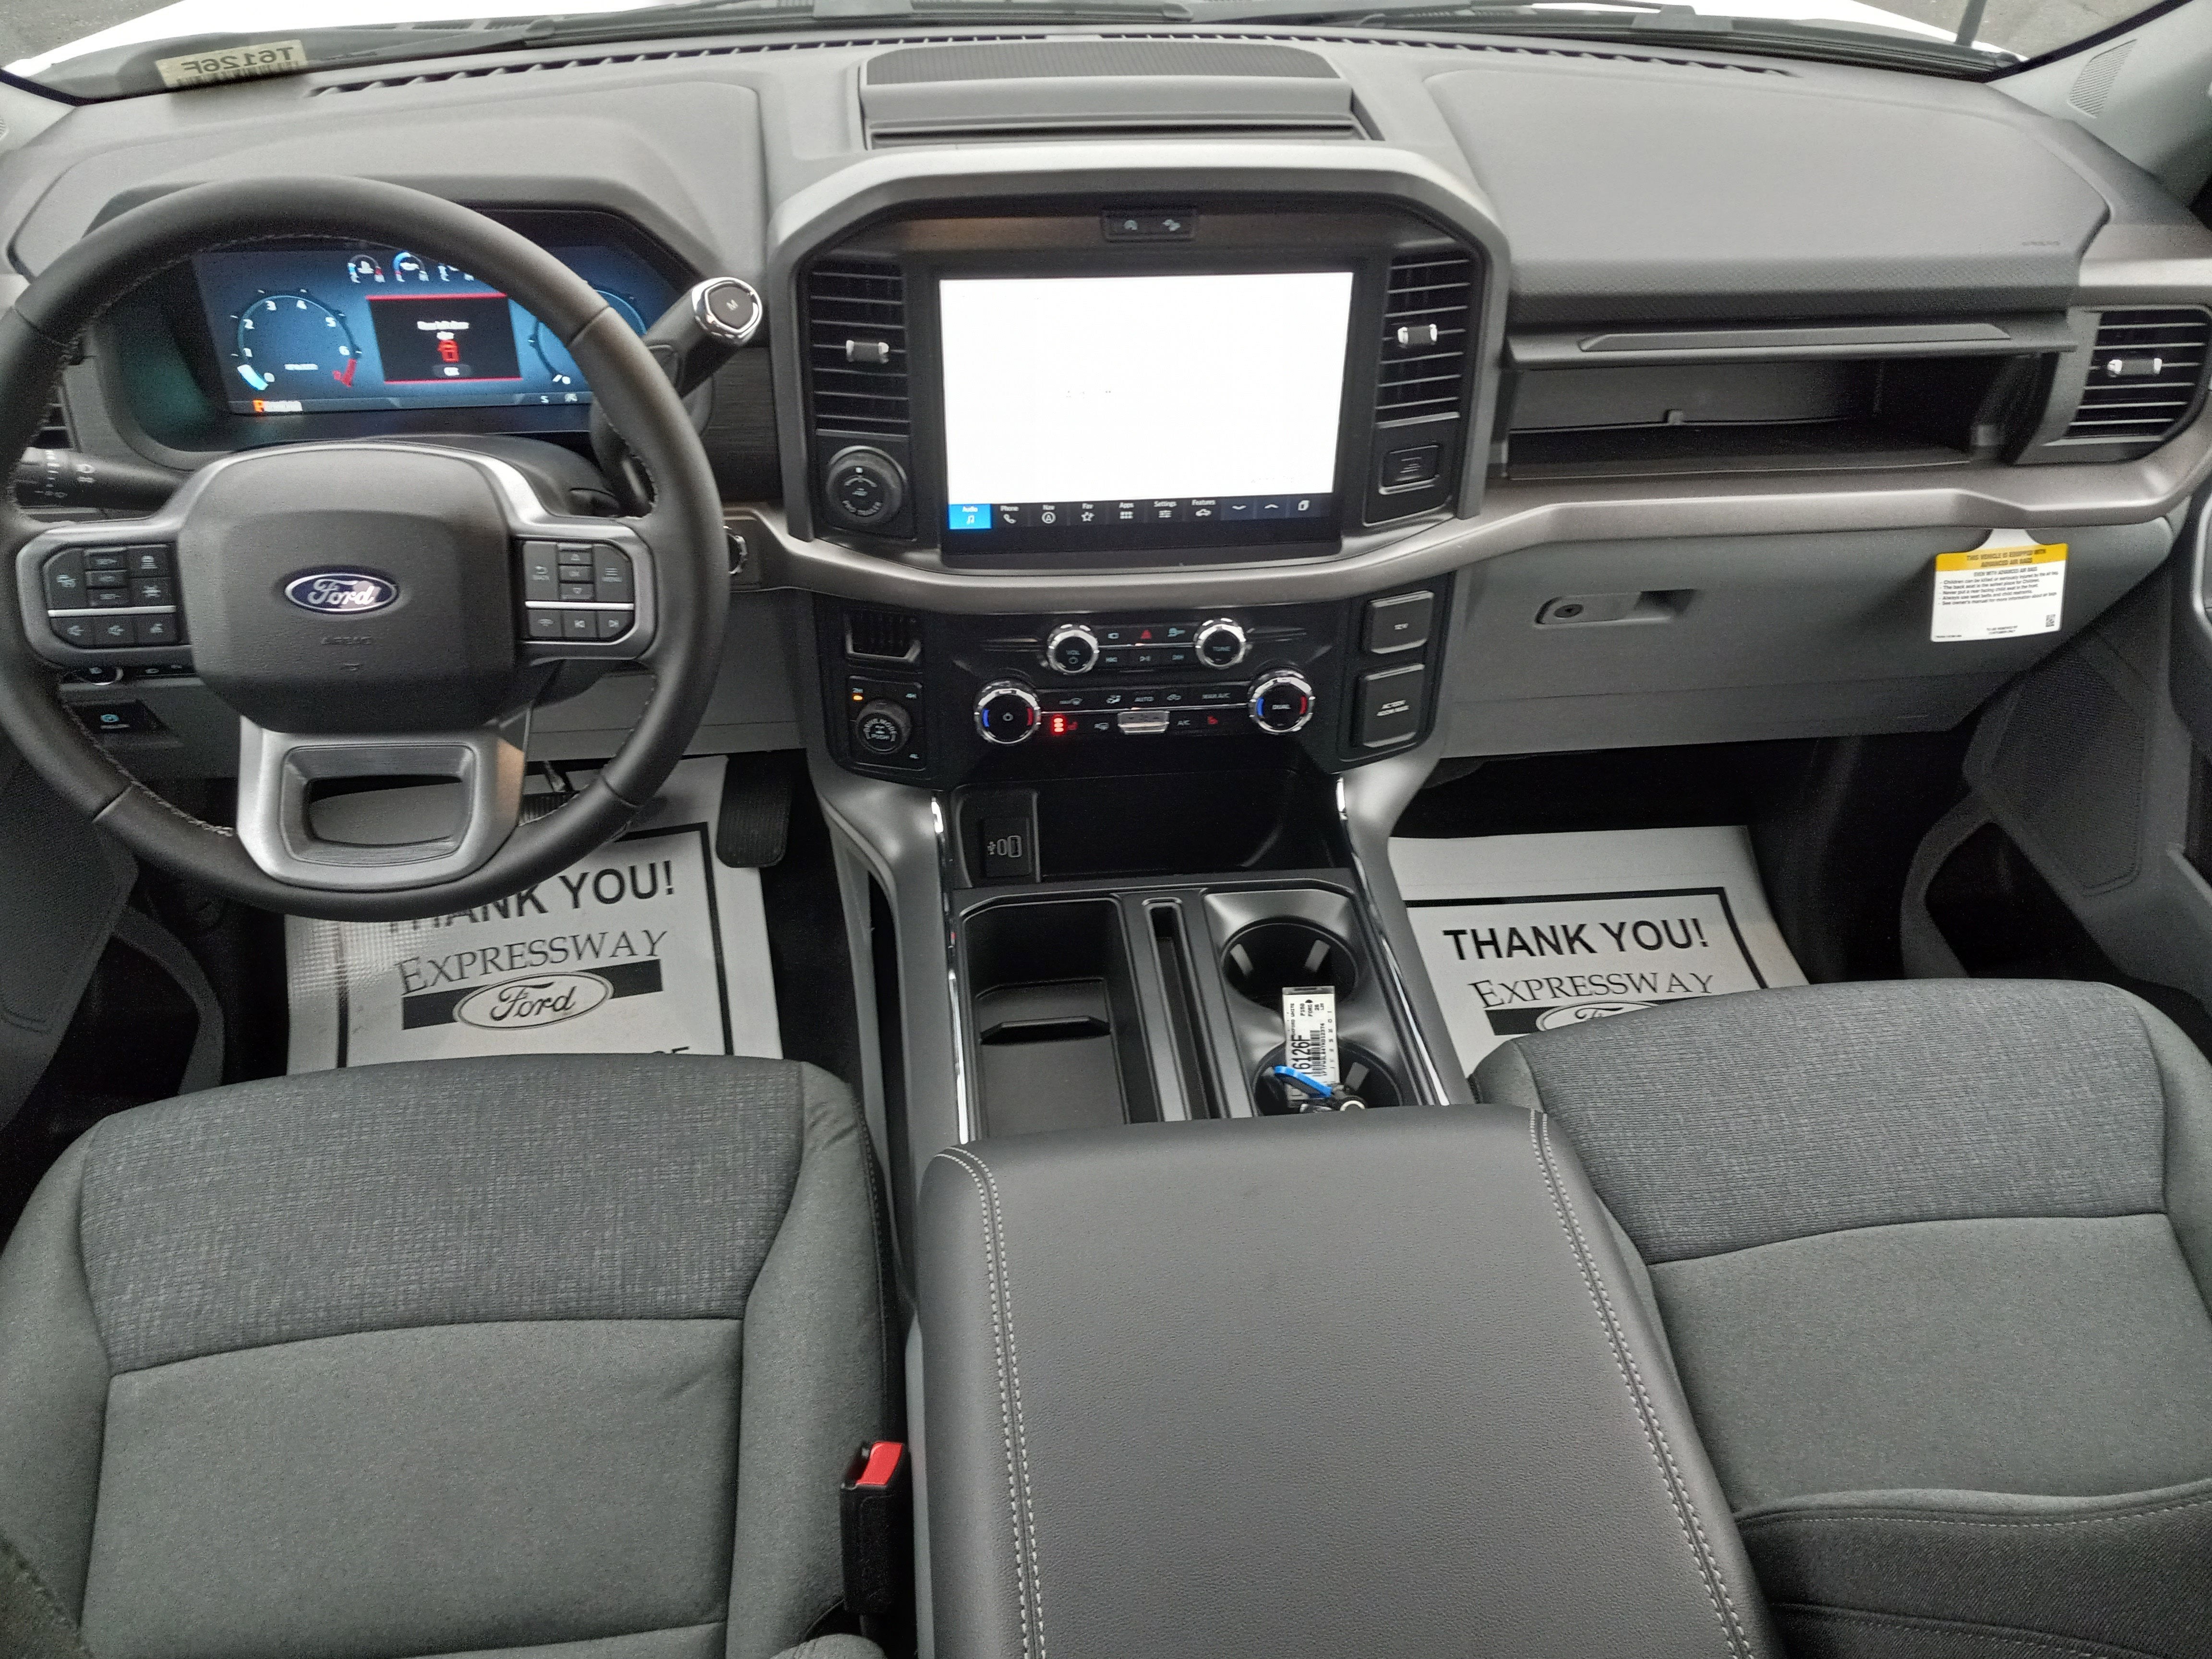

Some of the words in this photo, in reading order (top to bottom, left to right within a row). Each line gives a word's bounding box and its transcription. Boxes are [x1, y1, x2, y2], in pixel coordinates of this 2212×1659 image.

[243, 318, 255, 329] 2
[265, 300, 277, 311] 3
[325, 316, 337, 327] 5
[338, 345, 350, 356] 6
[307, 578, 374, 605] Ford
[558, 860, 674, 909] YOU!
[1442, 923, 1597, 960] THANK
[1599, 917, 1709, 952] YOU!
[394, 930, 668, 996] EXPRESSWAY
[490, 982, 577, 1022] Ford
[1467, 972, 1714, 1009] EXPRESSWAY
[1290, 1034, 1311, 1074] 6126F
